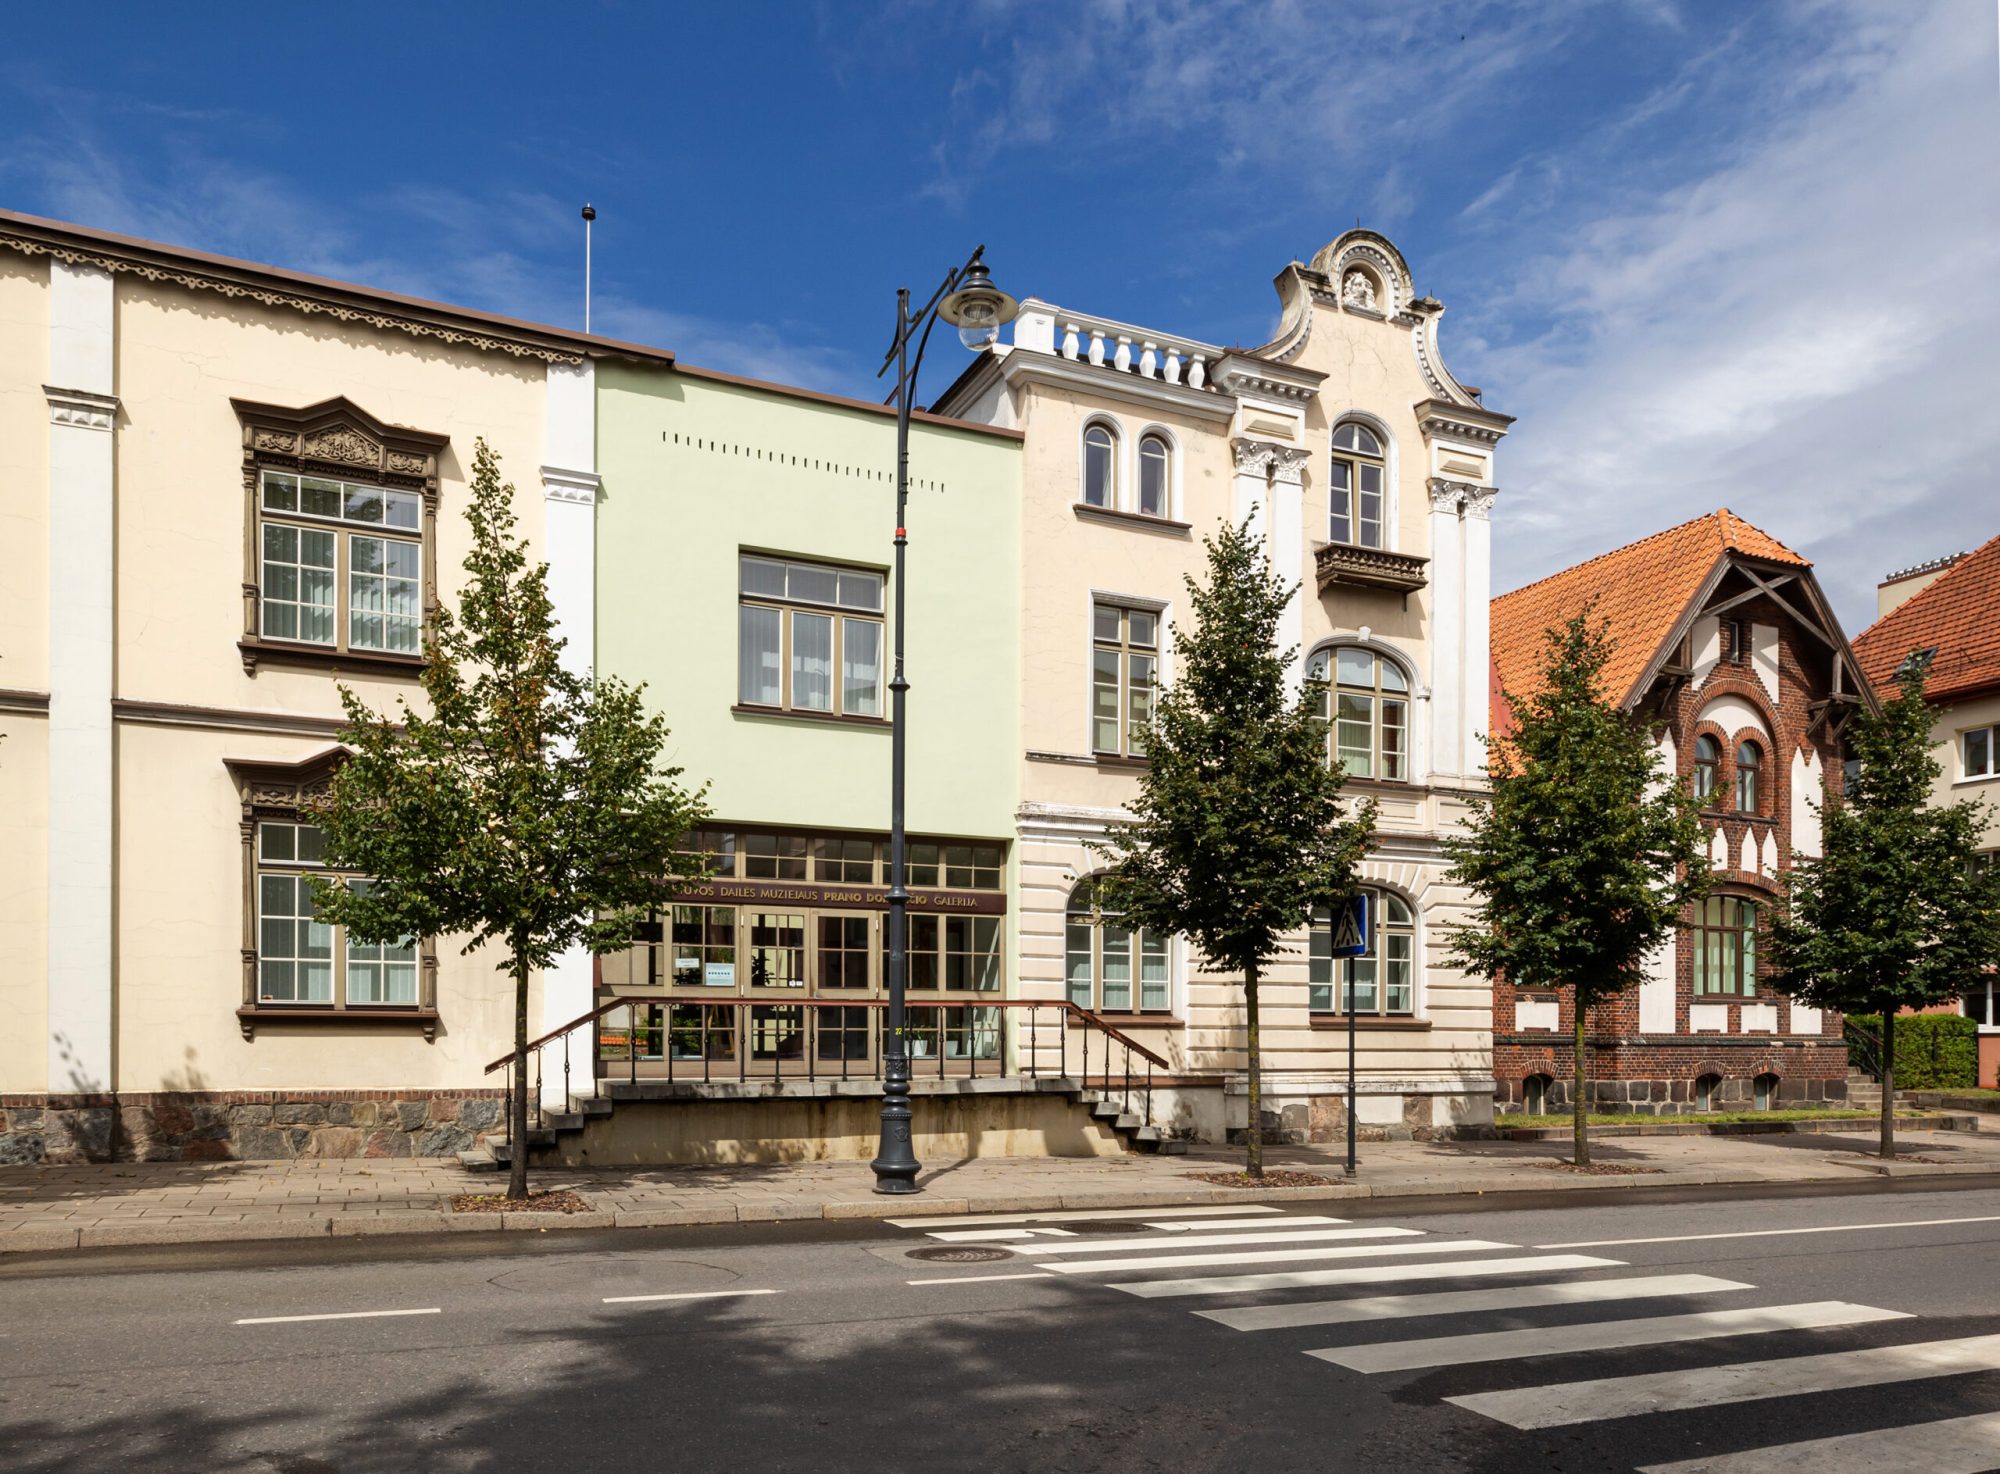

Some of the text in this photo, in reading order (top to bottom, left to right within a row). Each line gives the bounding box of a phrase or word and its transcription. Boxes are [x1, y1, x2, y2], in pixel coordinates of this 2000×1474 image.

[760, 890, 818, 900] MUZIEJAUS
[824, 892, 862, 902] PRANO
[934, 896, 977, 907] GALERIJA
[895, 1027, 903, 1035] 22
